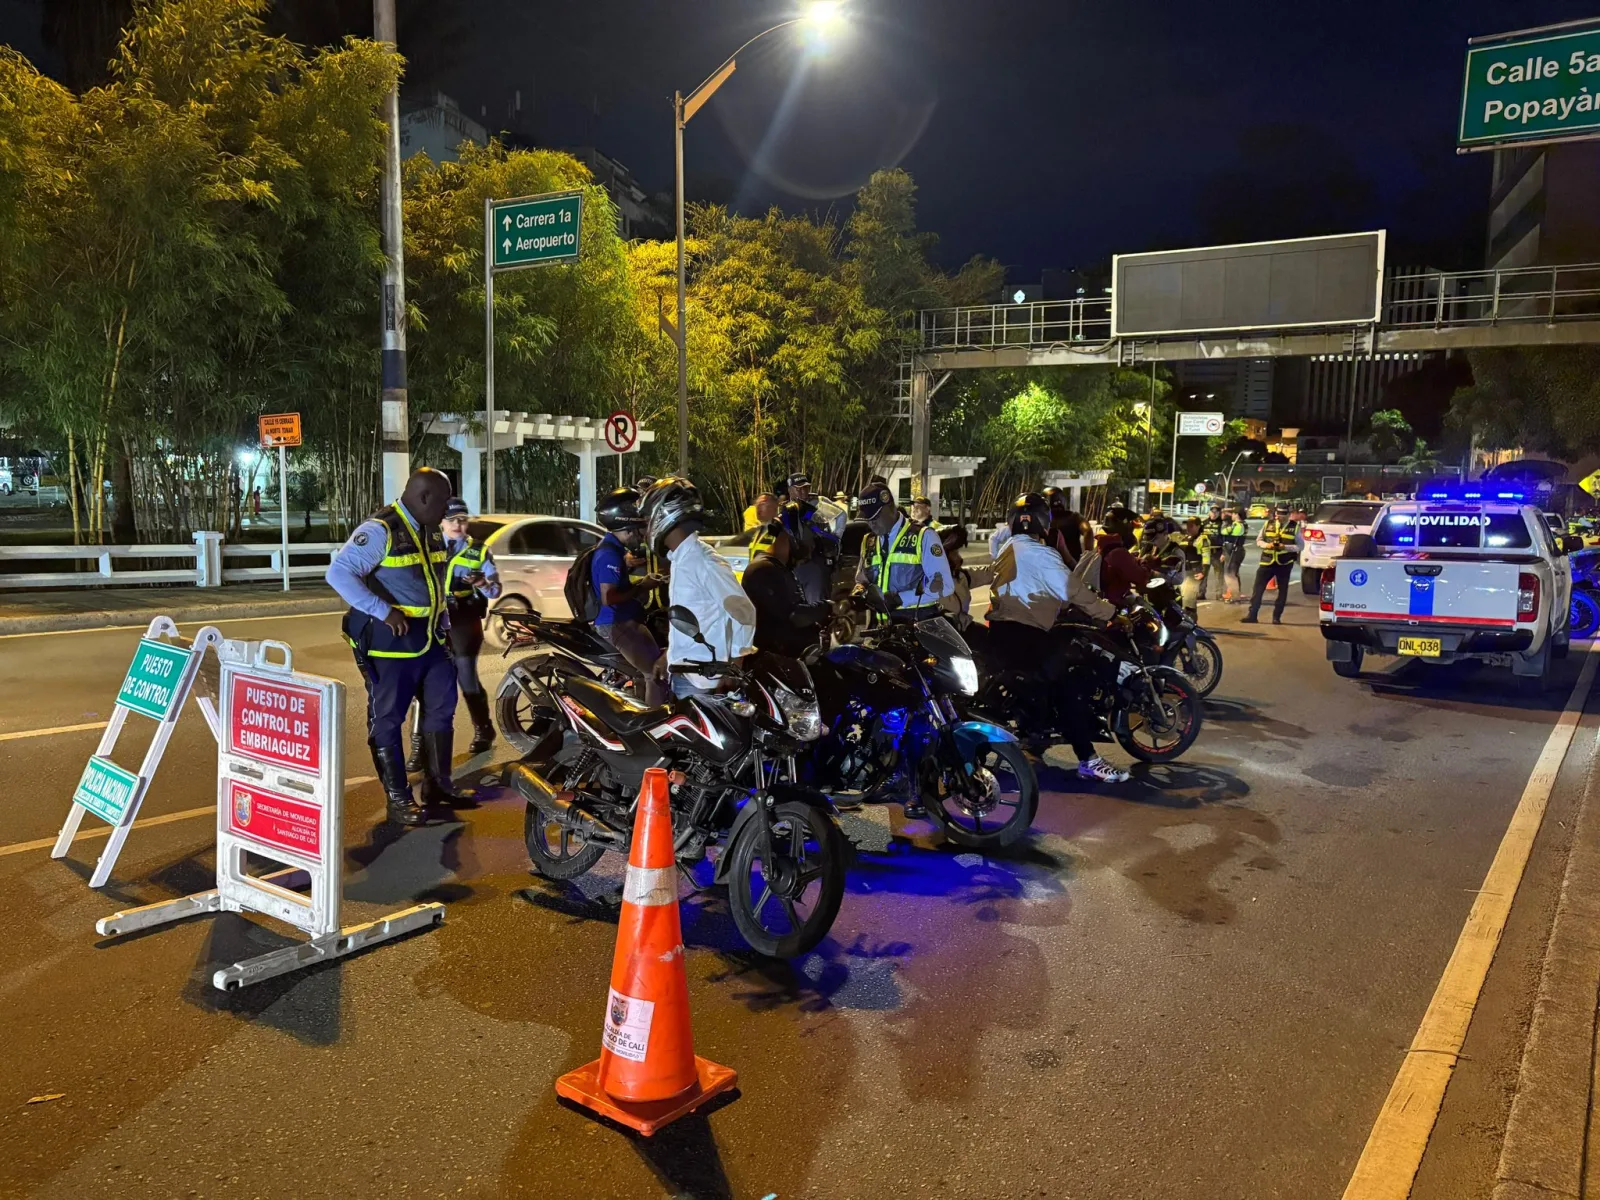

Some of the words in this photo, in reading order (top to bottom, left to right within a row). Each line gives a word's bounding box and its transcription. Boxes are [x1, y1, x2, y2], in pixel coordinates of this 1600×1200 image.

[1486, 56, 1560, 86] Calle
[516, 213, 555, 229] Carrera
[558, 208, 572, 223] 1a
[515, 231, 575, 252] Aeropuerto
[1406, 516, 1491, 526] MOVILIDAD
[900, 534, 918, 548] 619
[139, 653, 174, 678] PUESTO
[122, 675, 137, 695] DE
[133, 679, 170, 707] CONTROL
[246, 687, 287, 710] PUESTO
[290, 696, 306, 714] DE
[241, 708, 291, 734] CONTROL
[294, 720, 309, 738] DE
[240, 729, 311, 761] EMBRIAGUEZ
[100, 775, 130, 808] NACIONAL
[256, 803, 281, 815] SECRETARÍA
[282, 810, 290, 818] DE
[289, 812, 317, 825] MOVILIDAD
[277, 828, 299, 840] SANTIAGO
[299, 834, 306, 842] DE
[618, 1038, 628, 1047] DE
[623, 1032, 632, 1040] DE
